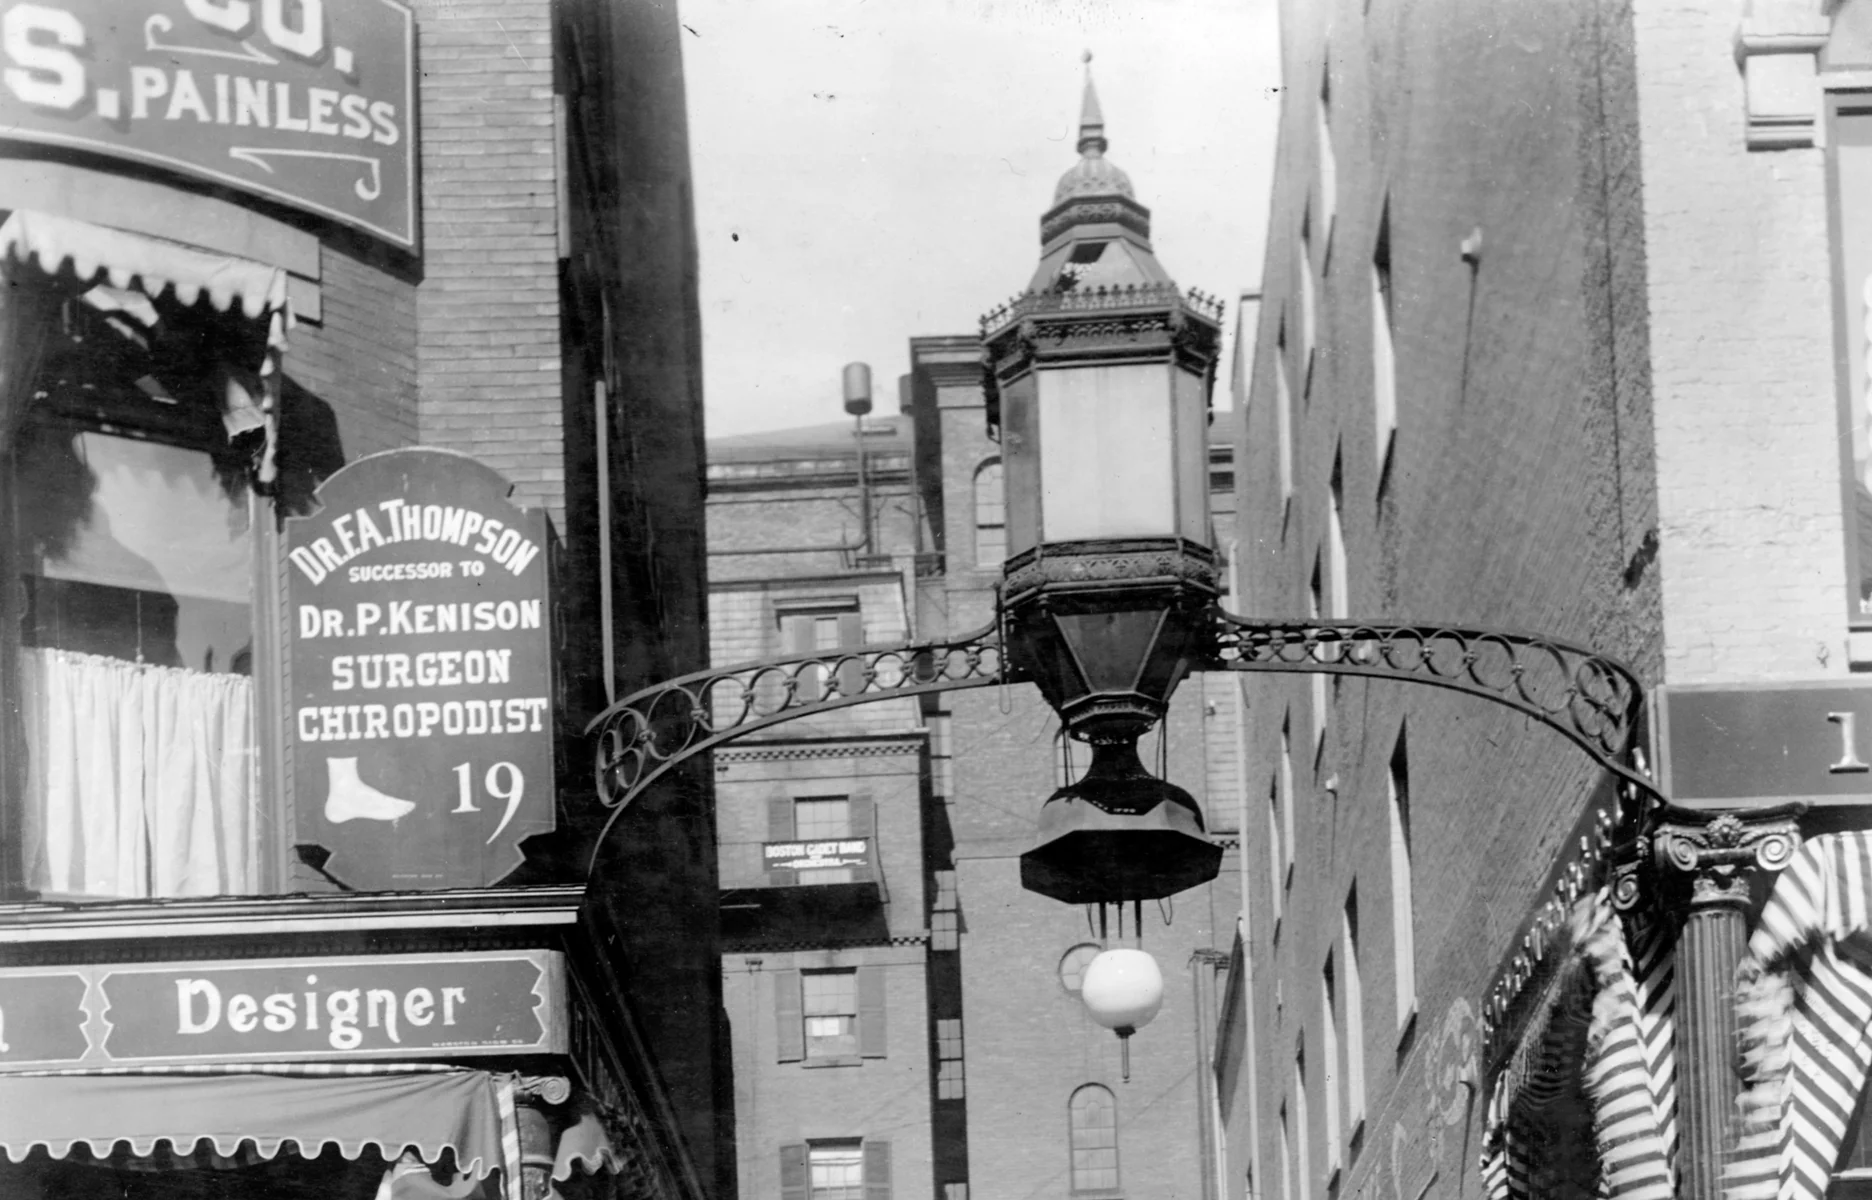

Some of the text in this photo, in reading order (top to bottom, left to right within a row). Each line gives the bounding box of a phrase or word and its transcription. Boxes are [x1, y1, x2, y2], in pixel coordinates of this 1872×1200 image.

[130, 65, 399, 146] PAINLESS
[349, 560, 486, 583] SUCCESSOR TO
[388, 599, 540, 635] KENISON
[332, 649, 512, 690] SURGEON
[298, 697, 548, 741] CHIROPODIST
[451, 761, 525, 845] 19
[764, 844, 805, 858] BOSTON
[176, 974, 467, 1050] Designer
